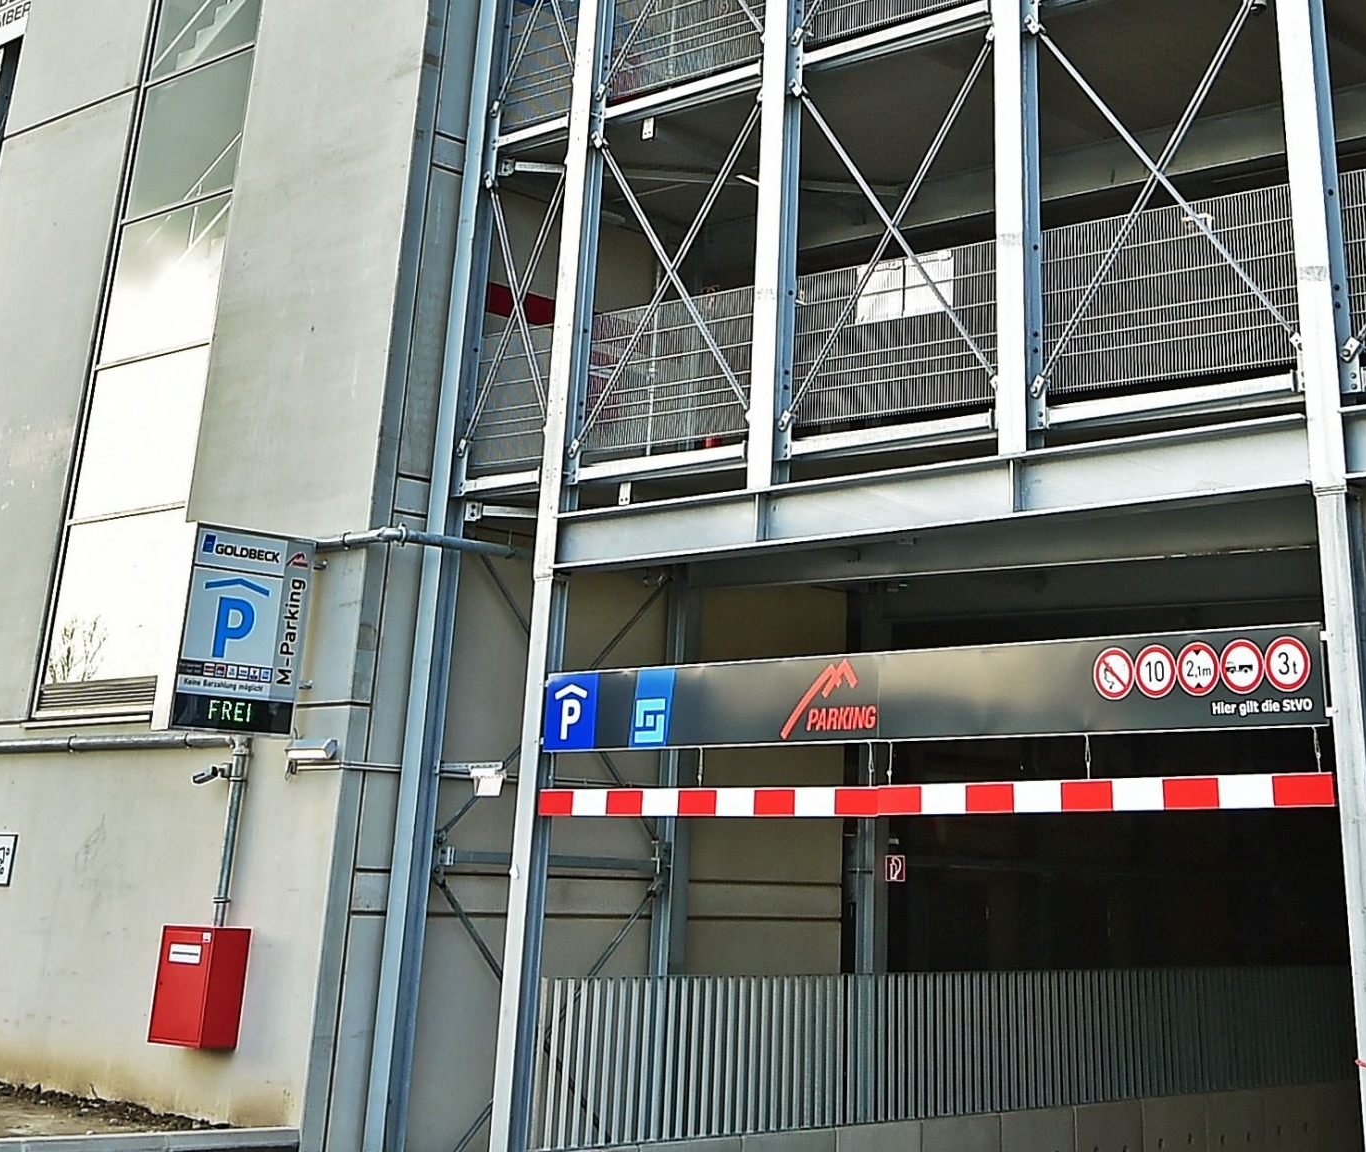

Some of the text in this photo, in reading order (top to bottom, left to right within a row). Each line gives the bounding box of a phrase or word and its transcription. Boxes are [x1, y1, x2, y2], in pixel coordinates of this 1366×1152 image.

[215, 543, 280, 563] GOLDBECK
[212, 596, 255, 658] P
[276, 578, 306, 685] M-Parking
[1145, 660, 1165, 683] 10
[183, 677, 201, 686] Keine
[203, 679, 237, 690] Barzahlung
[208, 699, 252, 722] FREI
[805, 705, 877, 732] PARKING
[1211, 698, 1313, 716] Hier gilt die StVO
[559, 698, 581, 740] P
